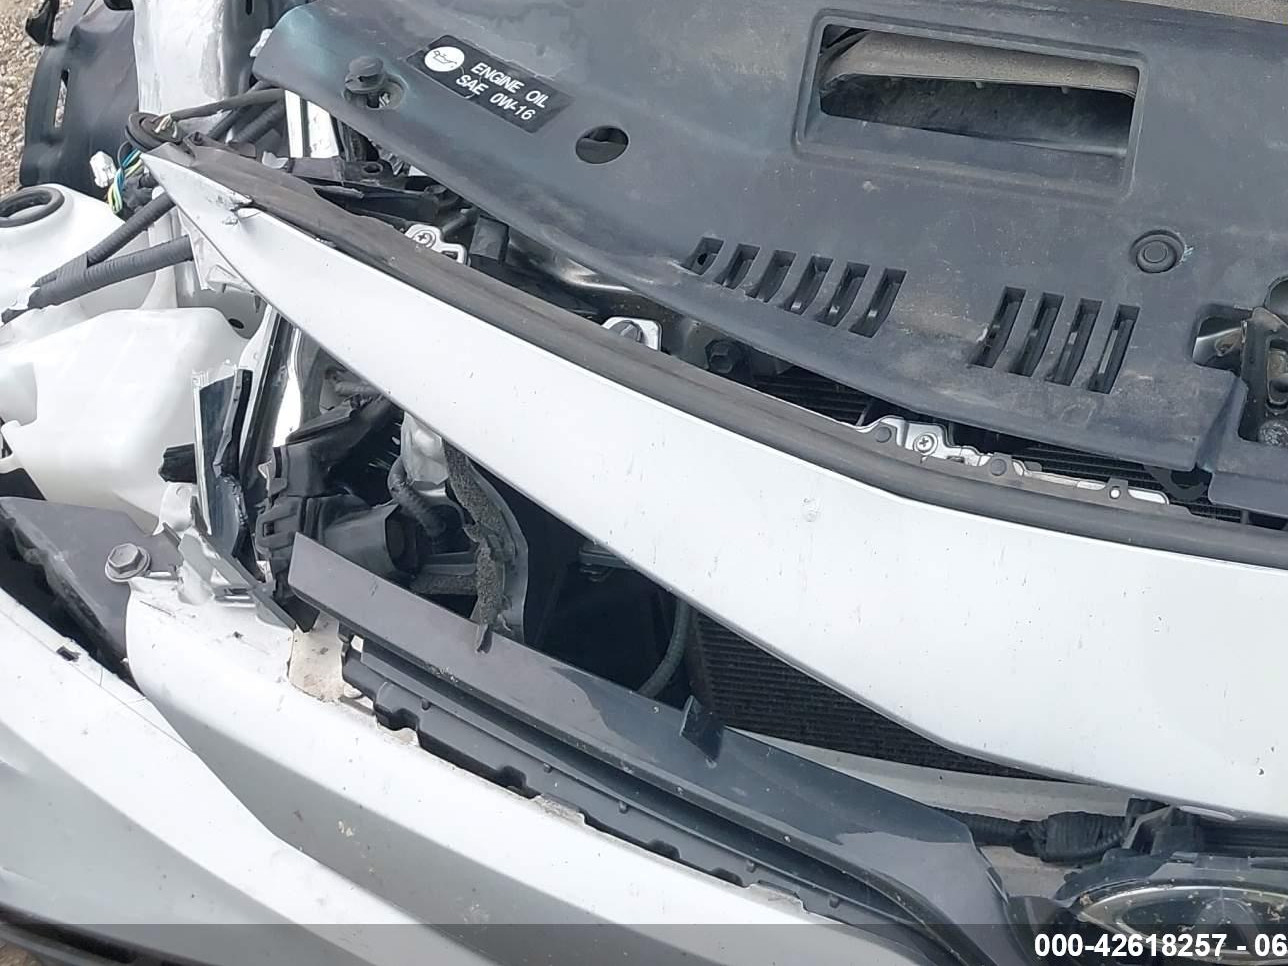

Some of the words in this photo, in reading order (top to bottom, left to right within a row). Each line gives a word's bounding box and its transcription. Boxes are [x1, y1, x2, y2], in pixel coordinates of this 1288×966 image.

[456, 74, 489, 96] SAE
[489, 92, 536, 121] 0W-16
[470, 62, 525, 94] ENGINE
[525, 90, 551, 109] OIL
